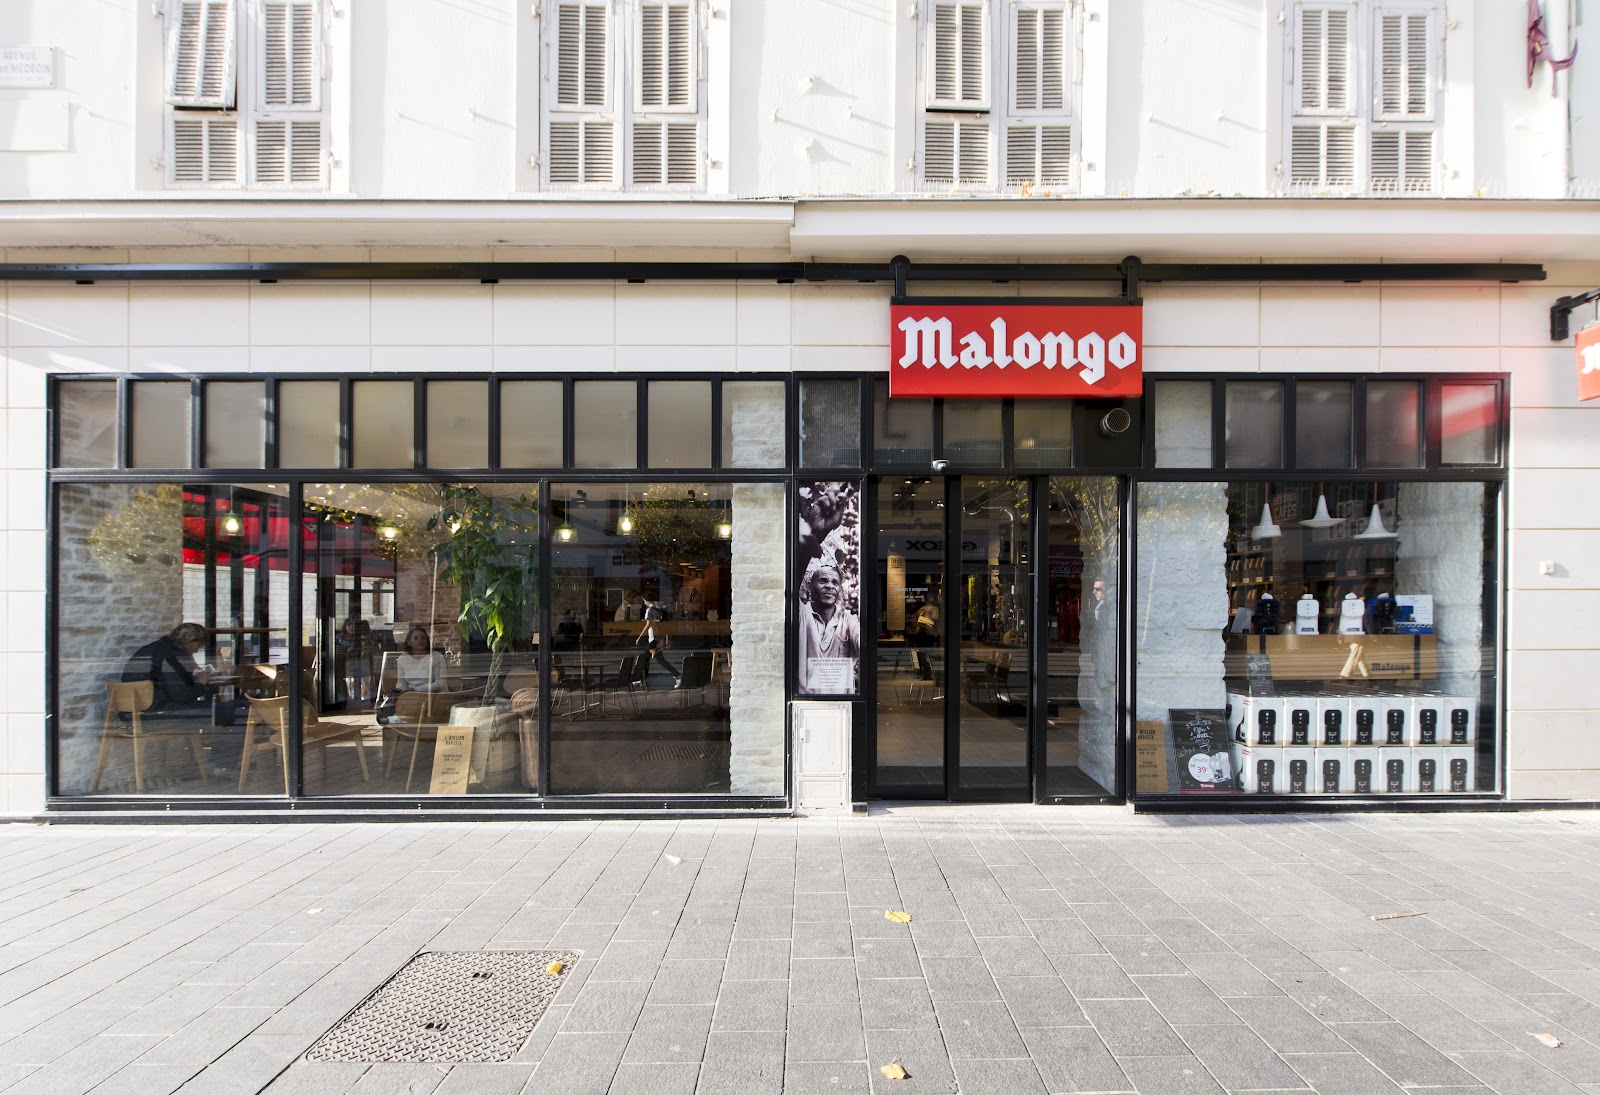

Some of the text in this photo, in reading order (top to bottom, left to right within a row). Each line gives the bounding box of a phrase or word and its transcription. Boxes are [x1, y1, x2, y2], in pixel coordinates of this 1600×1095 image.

[3, 51, 37, 61] AVENUE
[898, 316, 1137, 385] Malongo
[1371, 663, 1411, 673] Malongo
